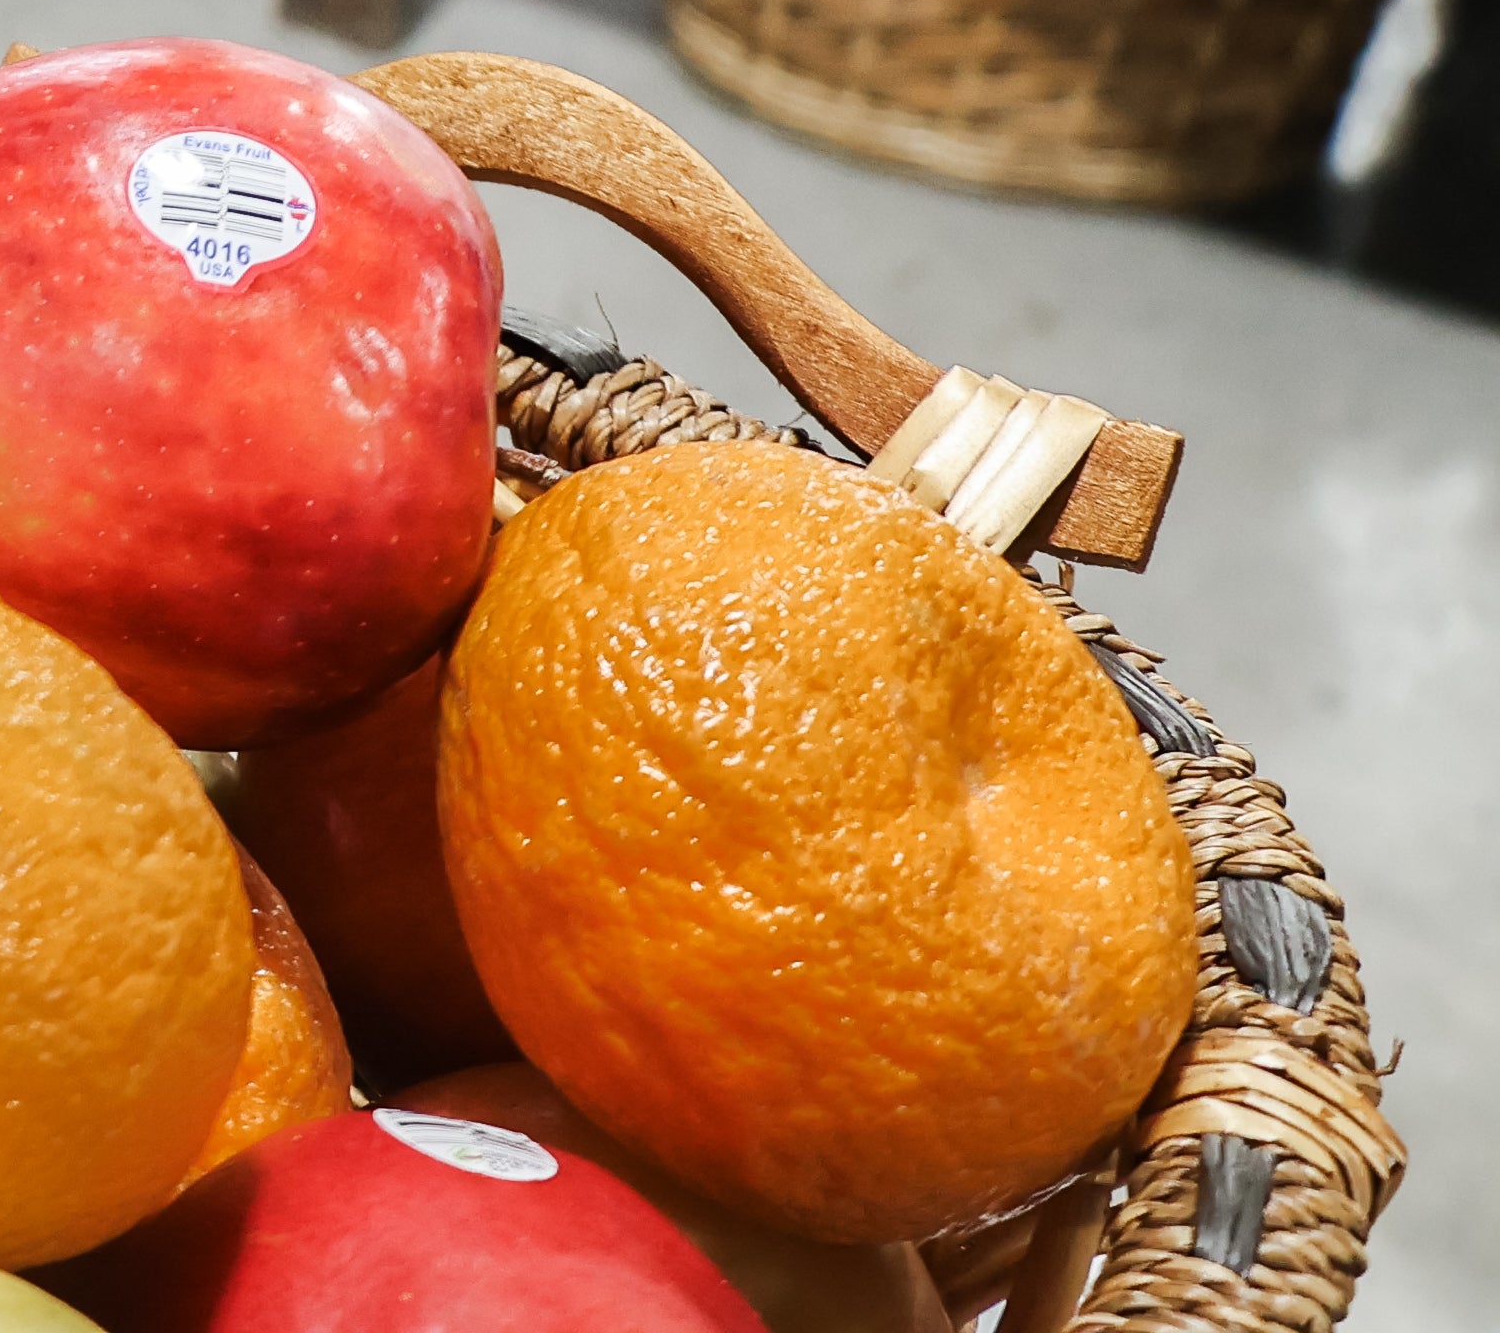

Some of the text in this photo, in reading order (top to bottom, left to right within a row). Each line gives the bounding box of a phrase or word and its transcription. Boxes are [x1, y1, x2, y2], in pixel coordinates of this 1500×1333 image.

[184, 136, 272, 160] Evans Fruit
[187, 236, 251, 266] 4016
[199, 263, 234, 278] USA
